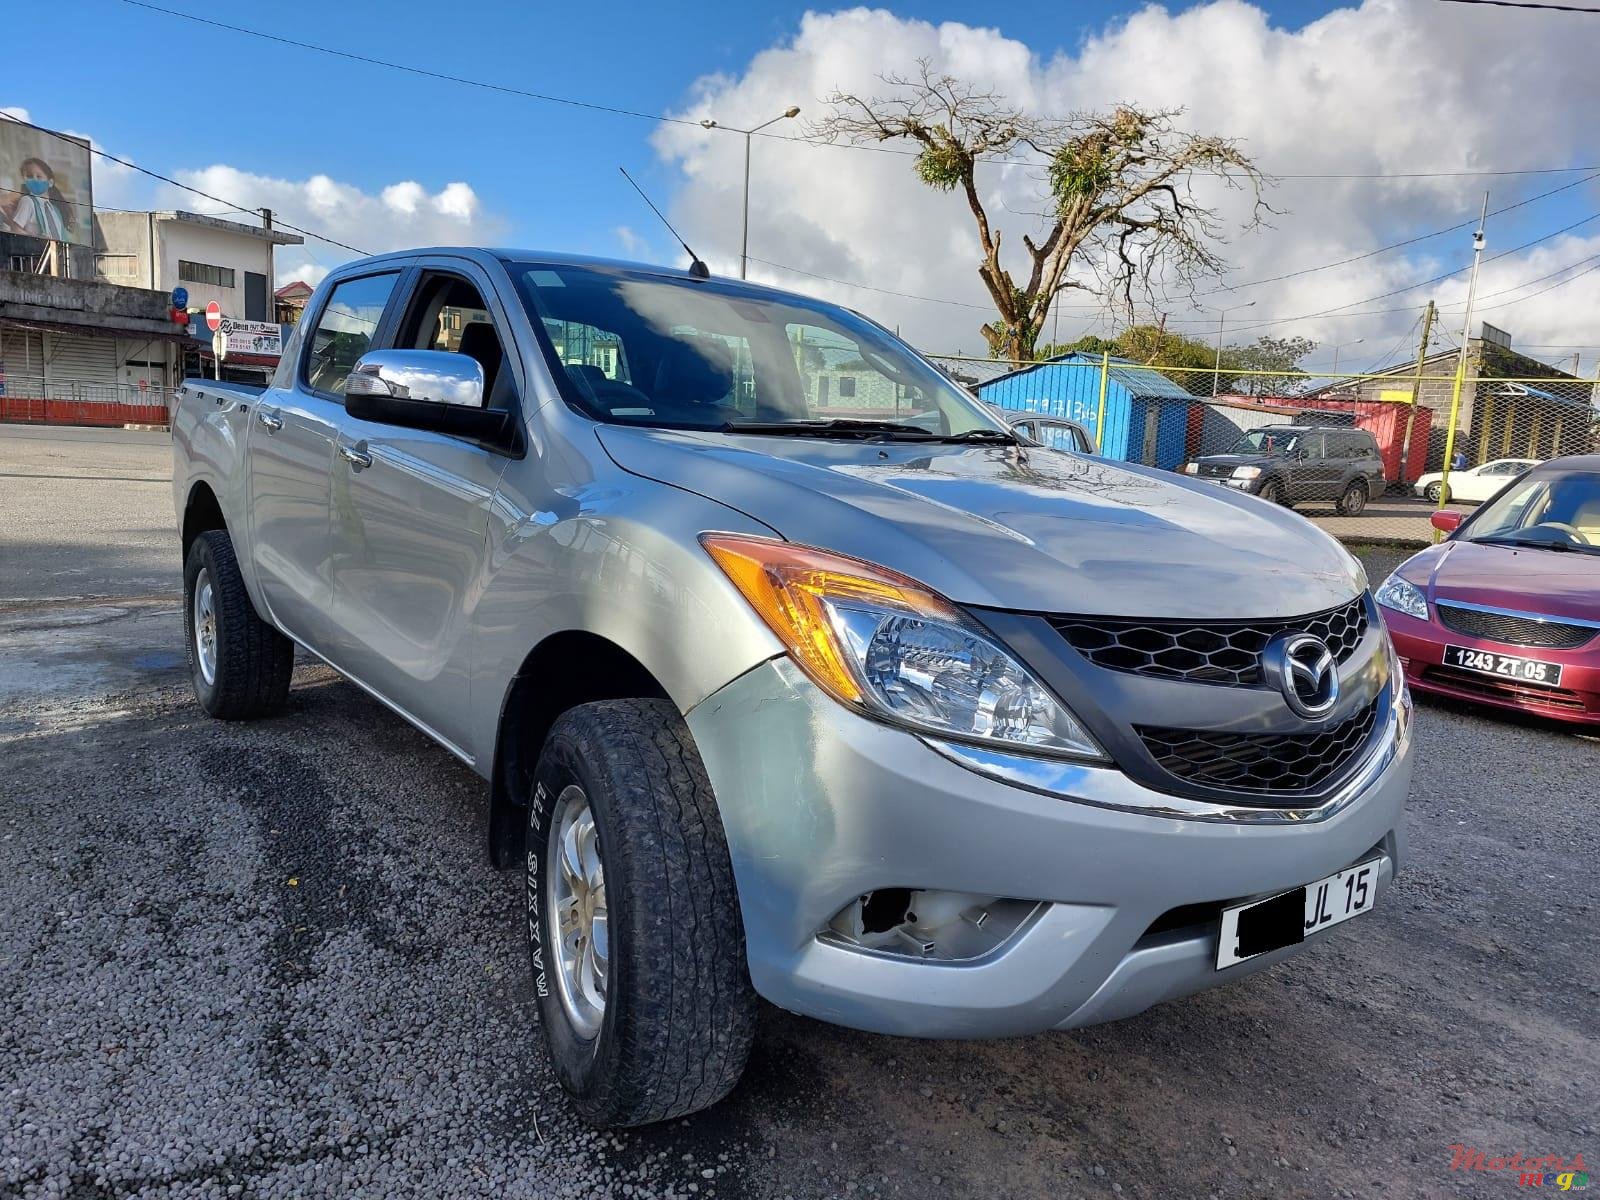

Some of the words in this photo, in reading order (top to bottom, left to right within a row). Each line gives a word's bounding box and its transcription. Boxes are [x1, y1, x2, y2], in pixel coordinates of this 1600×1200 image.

[1456, 649, 1494, 671] 1243
[1496, 657, 1521, 676] ZT
[1524, 661, 1547, 680] 05
[527, 850, 549, 998] MAXXIS
[1305, 883, 1333, 930] JL
[1345, 868, 1371, 914] 15
